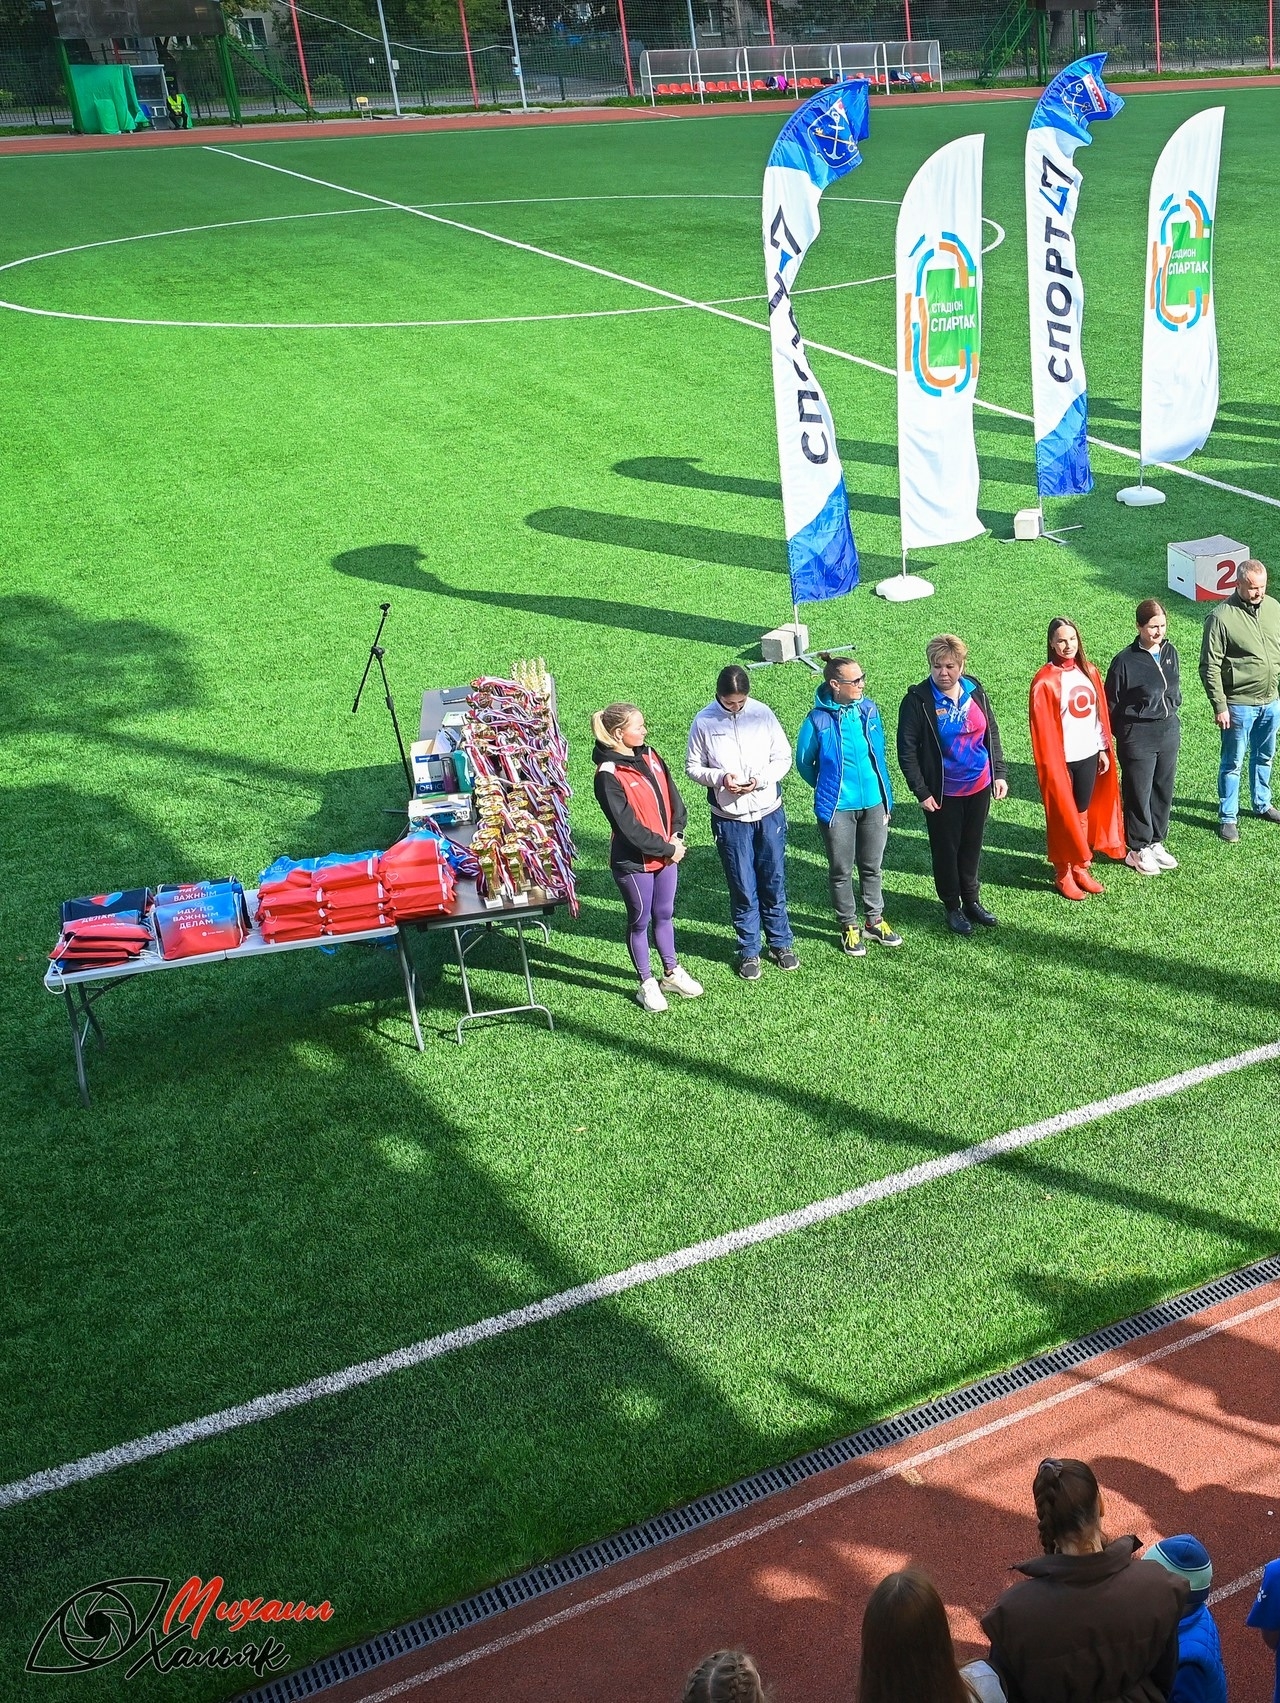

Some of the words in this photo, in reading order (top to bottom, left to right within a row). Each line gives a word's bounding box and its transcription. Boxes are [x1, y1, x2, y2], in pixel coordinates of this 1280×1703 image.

[1168, 261, 1209, 276] СПАРТАК
[930, 314, 976, 333] СПАРТАК
[1216, 559, 1237, 591] 2
[173, 890, 217, 902] ВАЖНЫМ
[172, 911, 219, 923] ВАЖНЫМ
[177, 907, 197, 915] ИДУ
[179, 919, 214, 931] ДЕЛАМ
